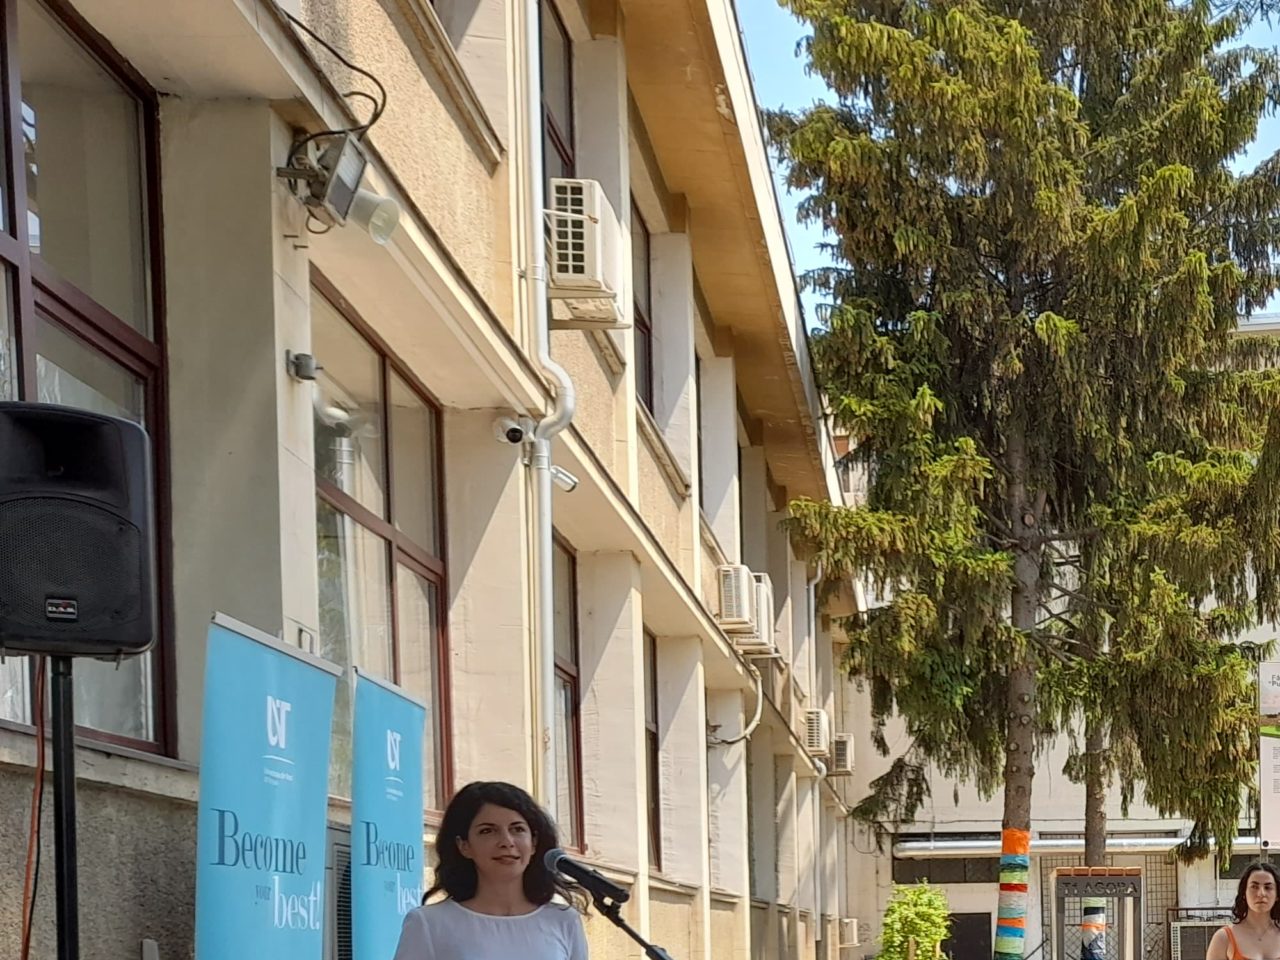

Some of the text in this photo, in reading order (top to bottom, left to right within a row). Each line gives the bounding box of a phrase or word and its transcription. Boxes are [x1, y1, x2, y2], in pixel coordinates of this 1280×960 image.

[210, 808, 306, 875] Become
[360, 820, 414, 873] Become
[272, 876, 320, 930] best!
